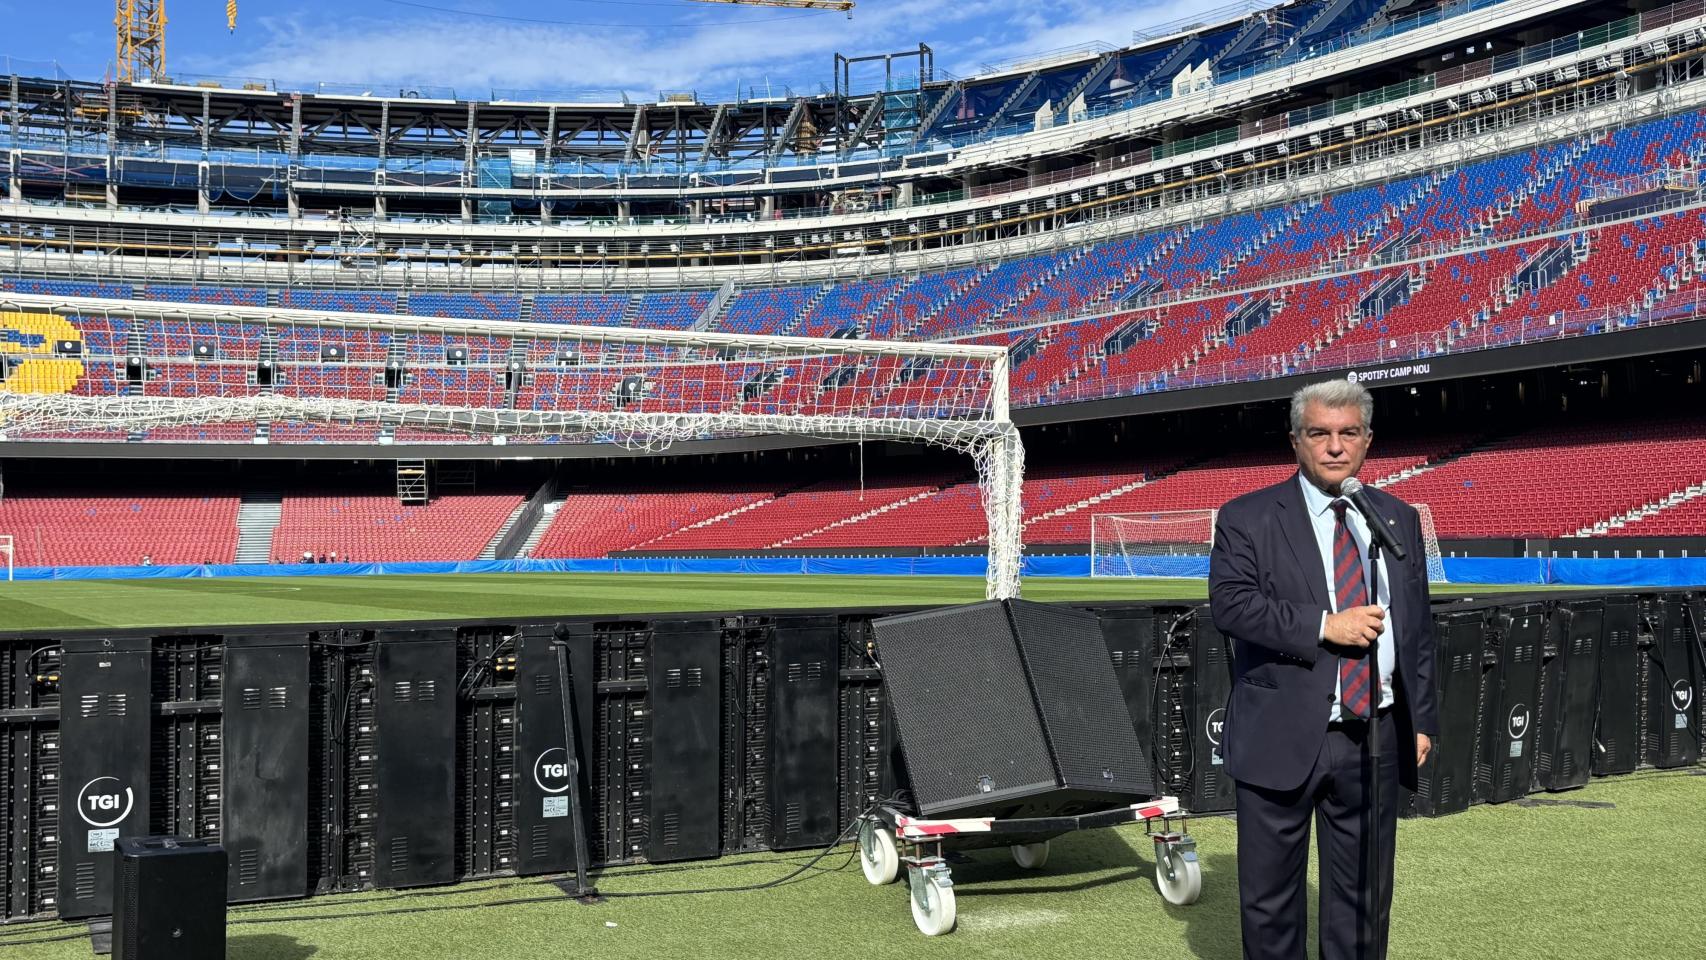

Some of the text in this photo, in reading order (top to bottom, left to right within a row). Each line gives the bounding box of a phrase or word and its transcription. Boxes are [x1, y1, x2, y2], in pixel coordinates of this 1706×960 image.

[1358, 363, 1430, 382] SPOTIFY CAMP NOU
[1211, 721, 1224, 733] TG
[1512, 715, 1525, 727] TGI
[542, 763, 568, 778] TGI
[87, 794, 120, 810] TGI
